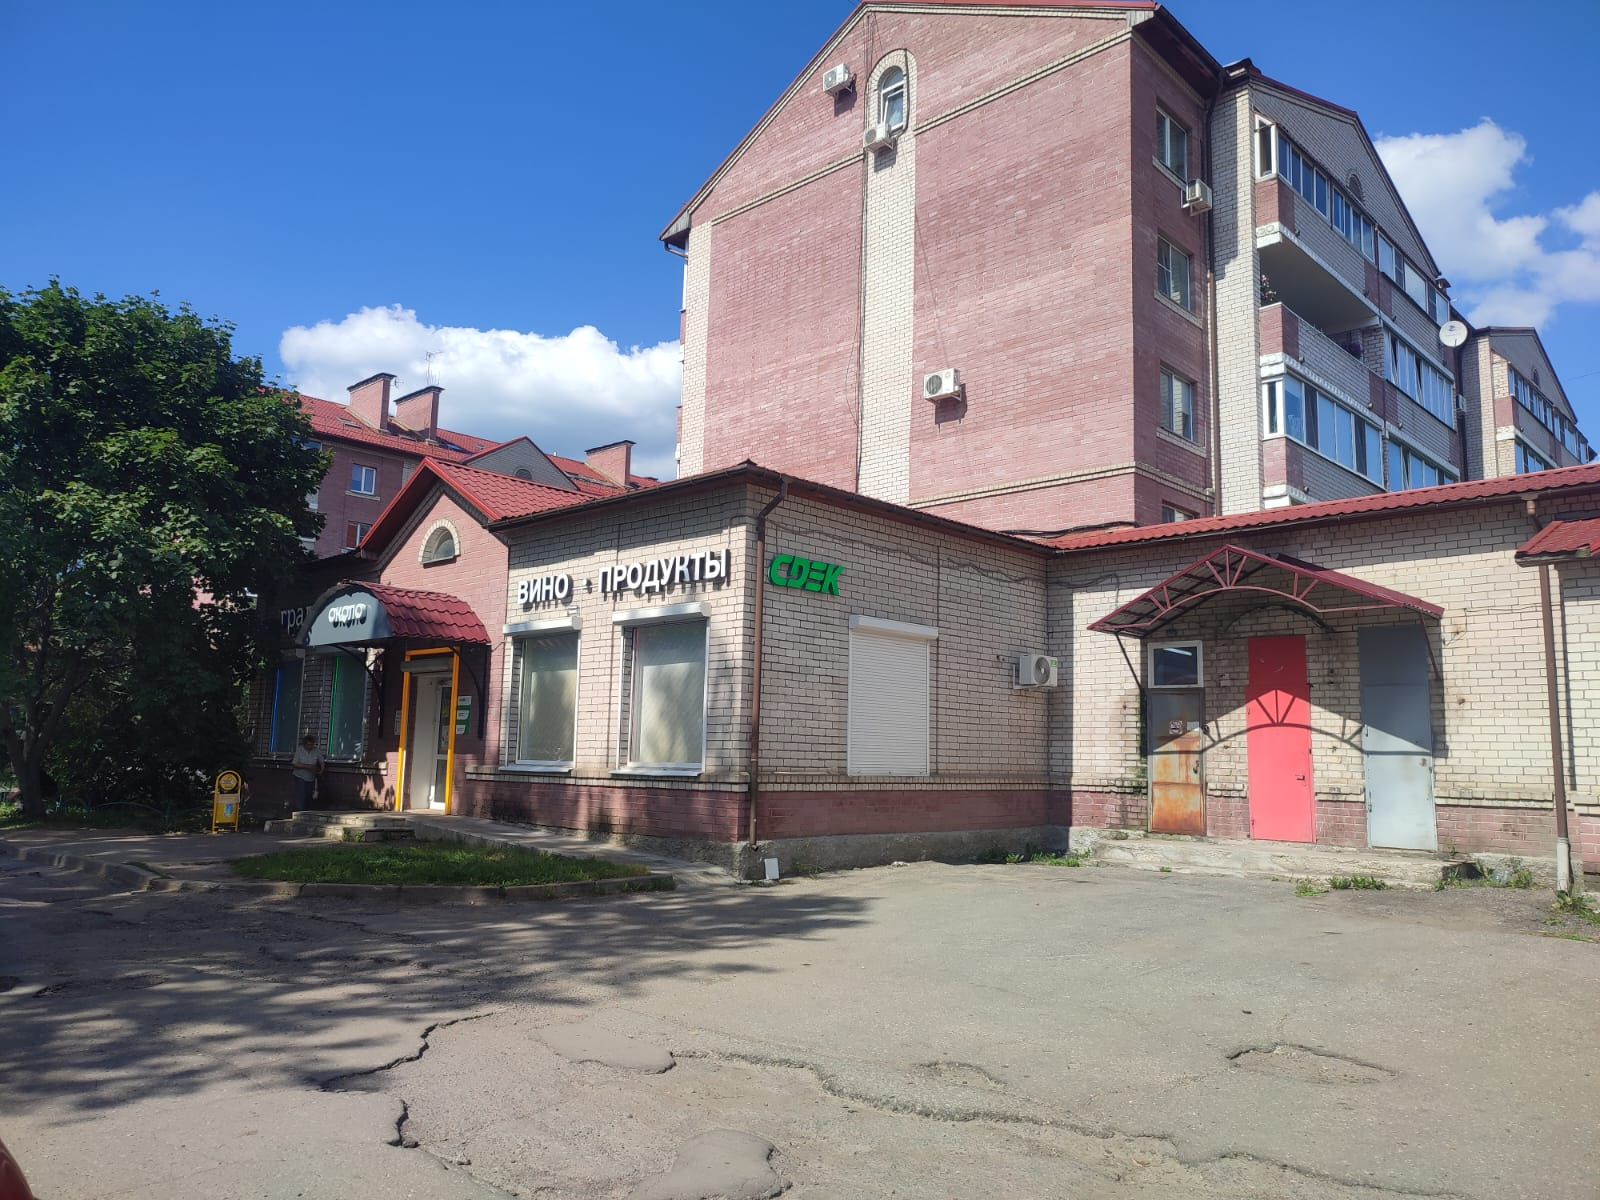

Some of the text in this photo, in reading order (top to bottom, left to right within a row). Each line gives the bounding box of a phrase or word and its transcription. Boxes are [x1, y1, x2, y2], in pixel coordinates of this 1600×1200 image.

[517, 548, 728, 604] ВИНО ПРОДУКТЫ
[769, 553, 845, 596] CDEK
[328, 603, 367, 624] около
